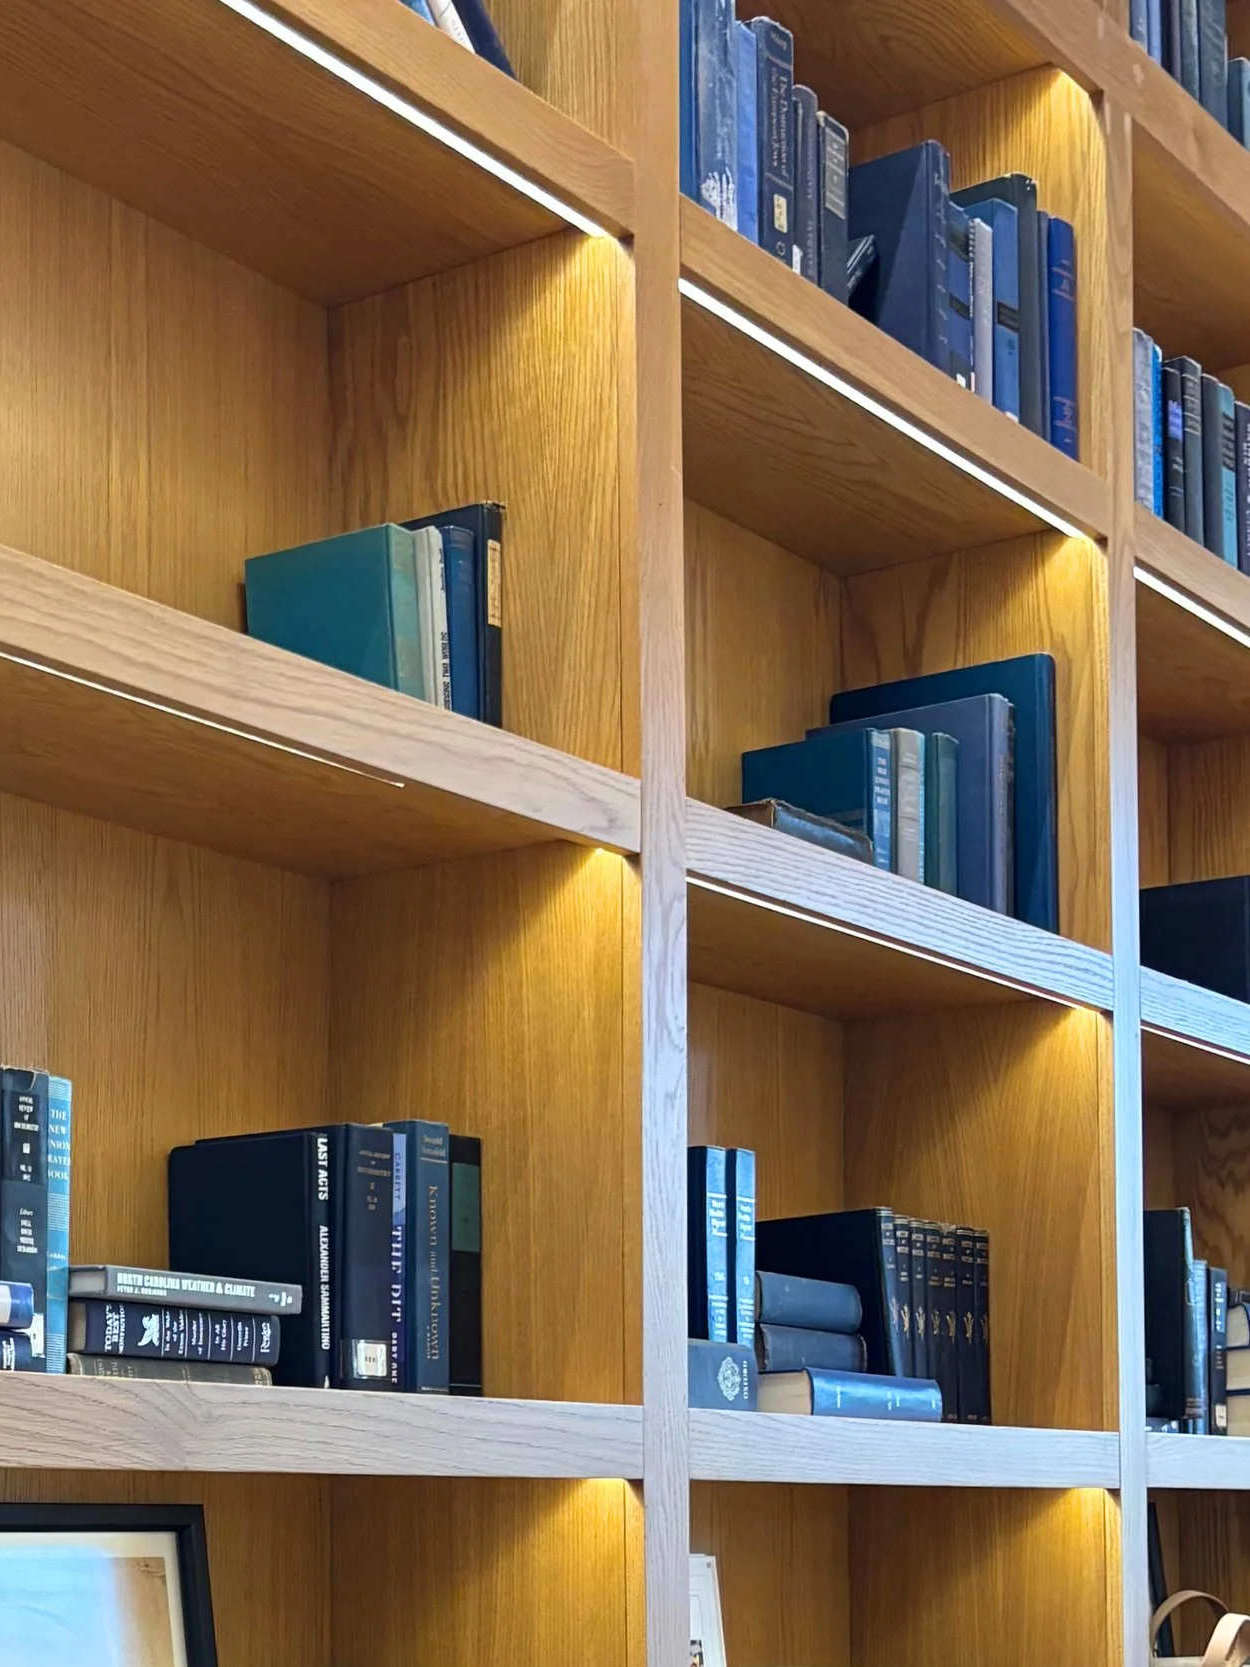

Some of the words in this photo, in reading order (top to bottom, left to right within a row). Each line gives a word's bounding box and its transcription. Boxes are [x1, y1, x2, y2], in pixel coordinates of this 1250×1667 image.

[50, 1109, 66, 1120] THE
[49, 1124, 66, 1135] NEW
[49, 1139, 70, 1151] NION
[317, 1138, 328, 1167] LAST
[318, 1170, 329, 1200] ACTS
[429, 1186, 438, 1246] Known
[319, 1225, 329, 1282] ALEXANDER
[117, 1273, 142, 1287] NORTH
[144, 1275, 180, 1290] CAROLINA
[182, 1279, 214, 1293] WEATHER
[216, 1283, 223, 1293] &
[225, 1283, 255, 1297] CLIMATE
[430, 1277, 441, 1360] Unknown
